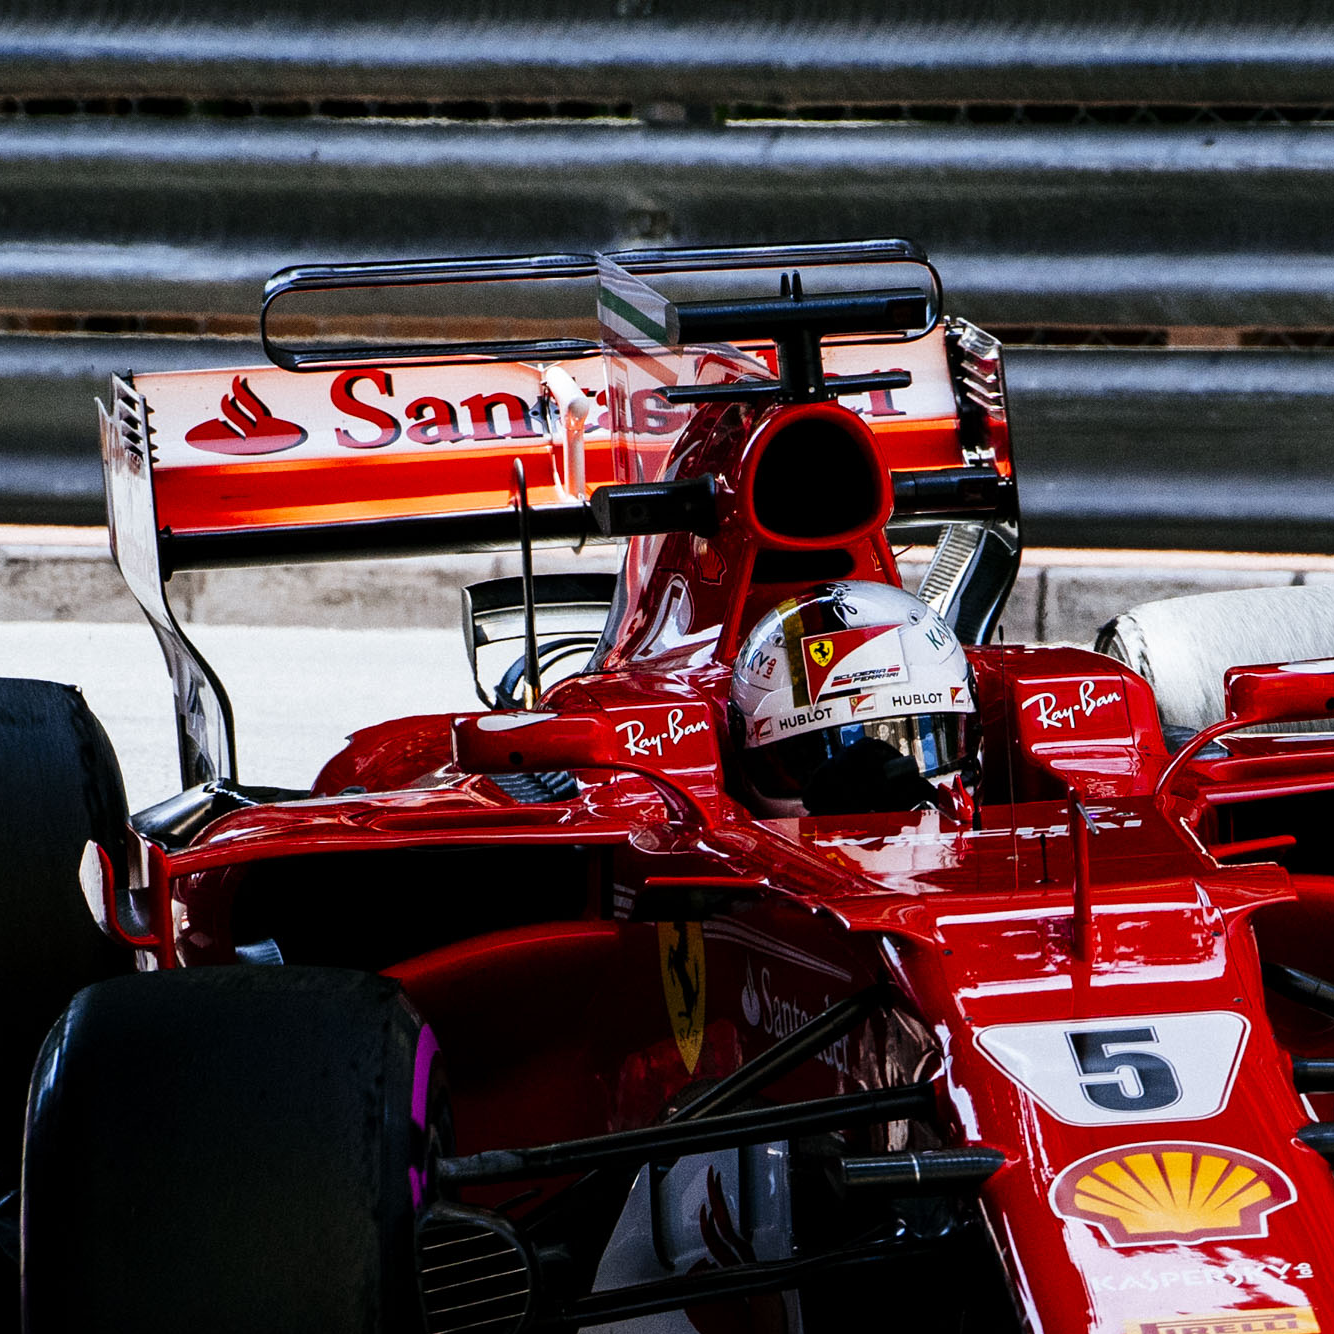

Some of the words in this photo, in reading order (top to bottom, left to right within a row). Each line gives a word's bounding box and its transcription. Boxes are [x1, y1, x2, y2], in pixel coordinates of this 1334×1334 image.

[779, 707, 833, 731] HUBLOT
[892, 692, 943, 707] HUBLOT
[1021, 680, 1121, 729] Ray-Ban
[615, 708, 709, 756] Ray-Ban
[1064, 1025, 1183, 1113] 5
